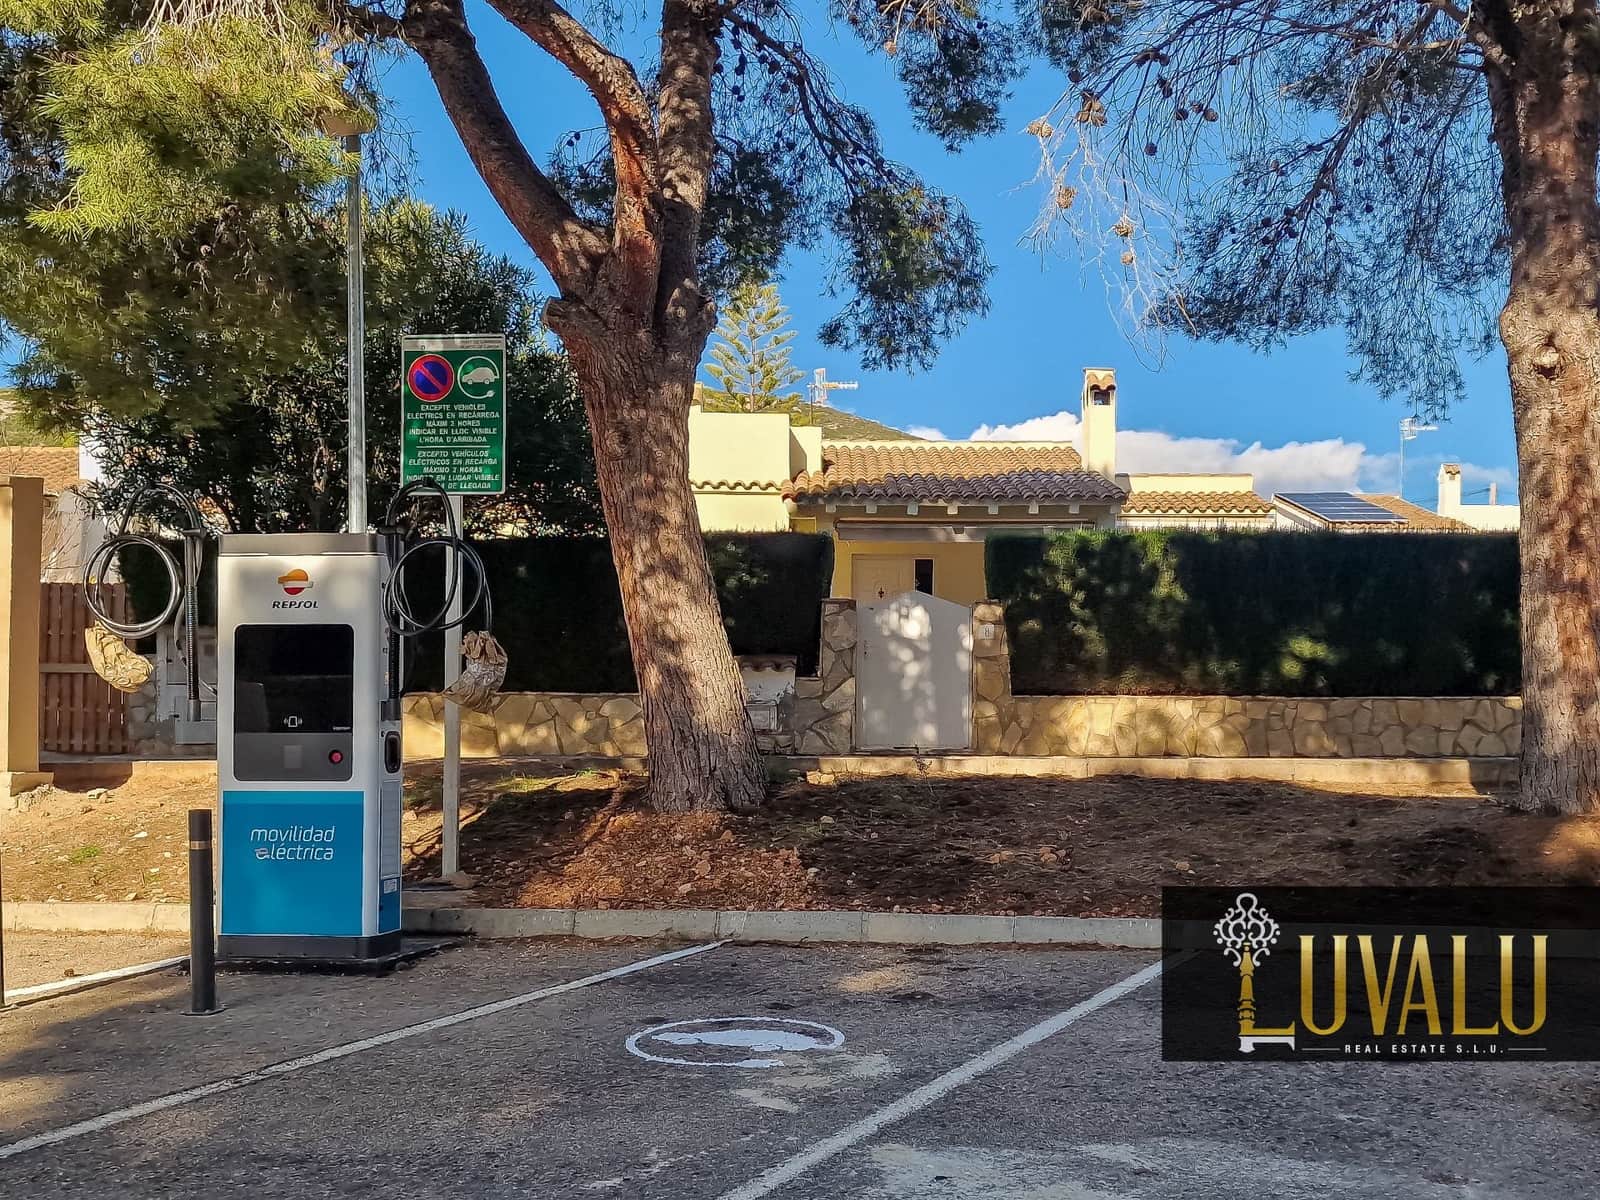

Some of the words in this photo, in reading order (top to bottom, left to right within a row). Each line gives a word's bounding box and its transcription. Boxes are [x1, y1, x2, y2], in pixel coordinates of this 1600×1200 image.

[272, 600, 319, 609] REPSOL
[250, 825, 336, 842] movilidad
[254, 842, 335, 861] eléctrica
